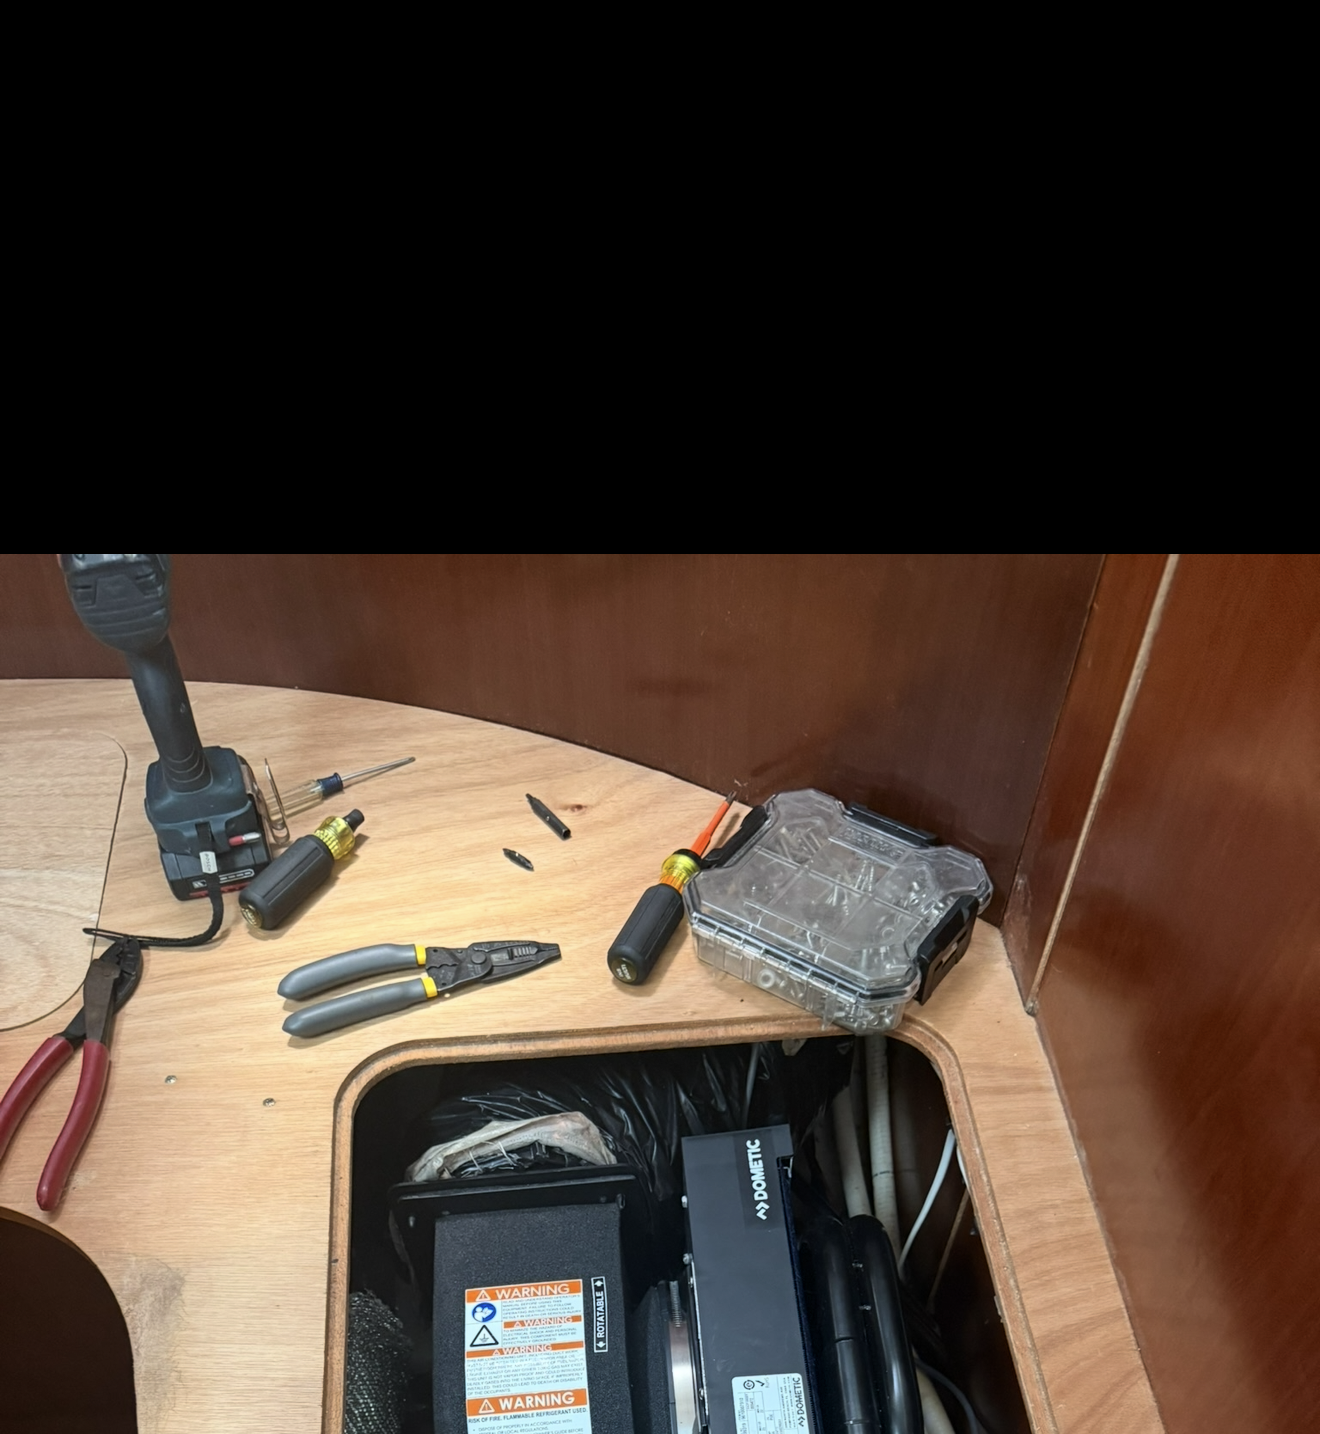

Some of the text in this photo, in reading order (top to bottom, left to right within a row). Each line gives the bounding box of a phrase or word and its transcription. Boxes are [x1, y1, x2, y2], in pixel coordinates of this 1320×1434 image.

[747, 1139, 768, 1201] DOMETIC
[495, 1284, 569, 1299] WARNING
[524, 1316, 572, 1327] WARNING
[502, 1344, 551, 1355] WARNING
[498, 1392, 574, 1411] WARNING
[792, 1376, 804, 1414] DOMETIC
[503, 1412, 534, 1420] FLAMMABLE
[535, 1408, 571, 1417] REFRIGERANT
